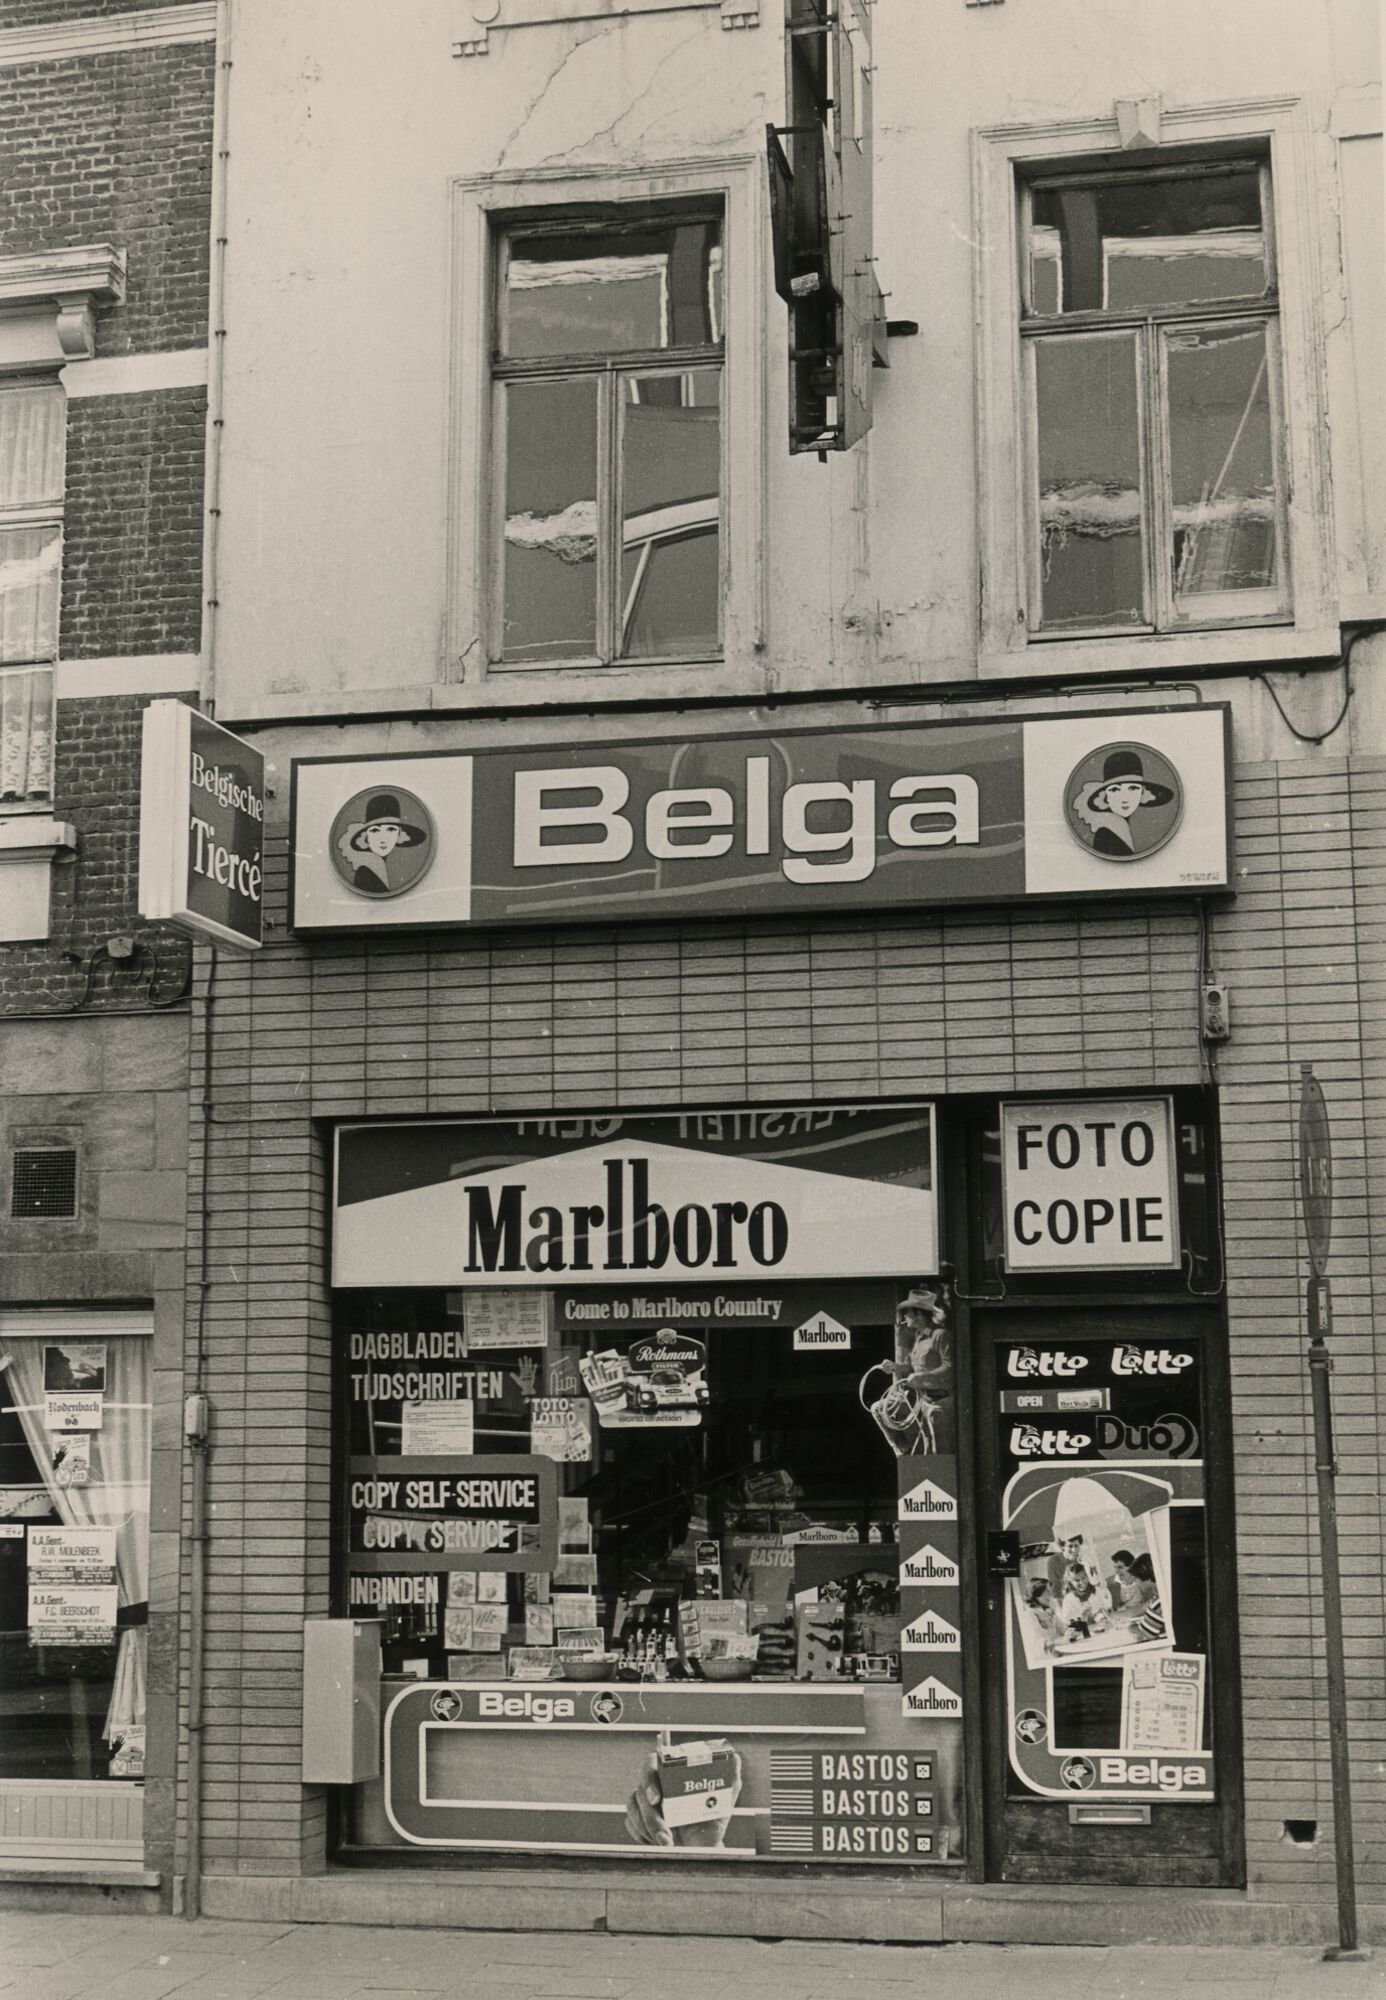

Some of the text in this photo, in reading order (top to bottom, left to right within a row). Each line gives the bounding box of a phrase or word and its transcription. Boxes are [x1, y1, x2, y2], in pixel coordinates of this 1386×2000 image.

[191, 751, 263, 823] Belgische
[513, 756, 981, 884] Belga
[190, 816, 262, 902] Tiercé
[1017, 1120, 1154, 1170] FOTO
[463, 1157, 789, 1273] Marlboro
[1013, 1197, 1163, 1246] COPIE
[564, 1299, 610, 1320] Come
[612, 1299, 630, 1319] to
[631, 1297, 711, 1319] Marlboro
[713, 1296, 783, 1320] Country
[351, 1331, 469, 1360] DAGBLADEN
[798, 1321, 847, 1344] Marlboro
[635, 1346, 698, 1363] Rothmans
[1007, 1347, 1089, 1377] Lotto
[1111, 1345, 1194, 1375] Lotto
[351, 1372, 503, 1400] TIJDSCHRIFTEN
[532, 1411, 575, 1424] LOTTO
[656, 1414, 682, 1422] action
[1010, 1425, 1092, 1455] Lotto
[1096, 1413, 1198, 1459] Duo
[351, 1479, 535, 1509] COPY SELF-SERVICE
[903, 1490, 953, 1513] Marlboro
[363, 1520, 510, 1549] COPY SERVICE
[798, 1531, 838, 1542] Marlboro
[748, 1548, 795, 1568] BASTOS
[904, 1555, 955, 1578] Marlboro
[350, 1576, 439, 1604] INBINDEN
[906, 1621, 956, 1644] Marlboro
[479, 1691, 575, 1723] Belga
[907, 1688, 958, 1710] Marlboro
[821, 1755, 909, 1780] BASTOS
[1099, 1757, 1207, 1793] Belga
[683, 1778, 725, 1793] Belga
[821, 1789, 910, 1816] BASTOS
[821, 1825, 910, 1853] BASTOS
